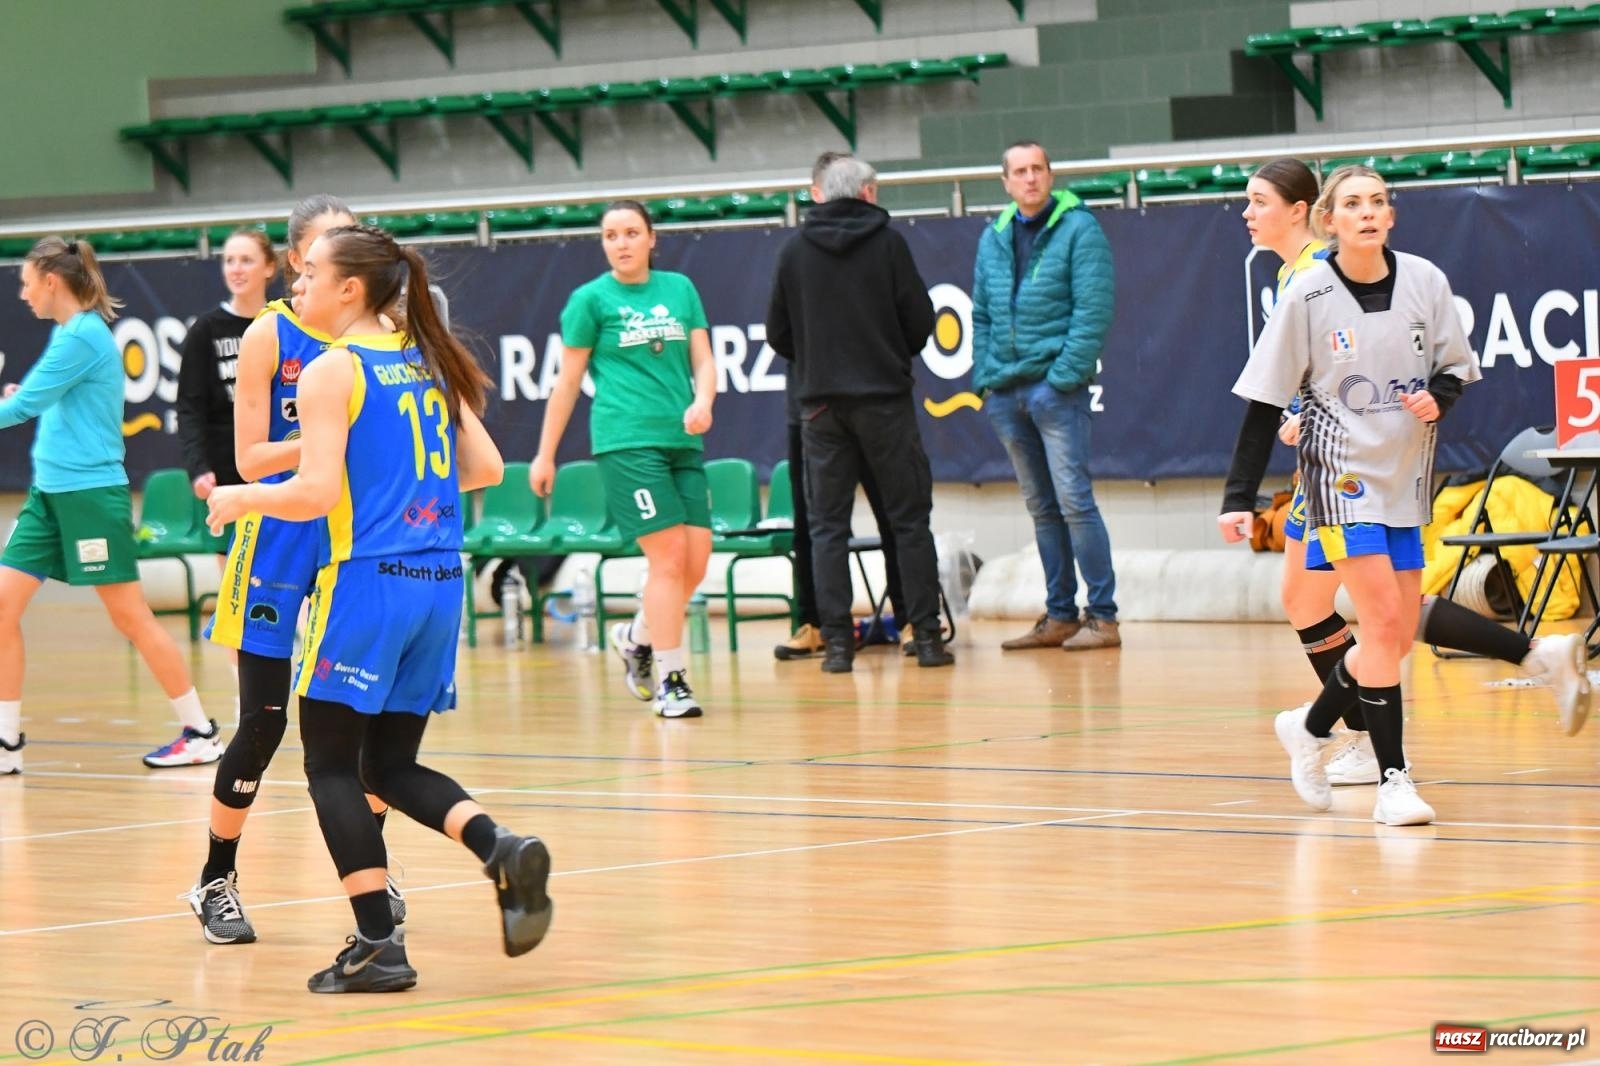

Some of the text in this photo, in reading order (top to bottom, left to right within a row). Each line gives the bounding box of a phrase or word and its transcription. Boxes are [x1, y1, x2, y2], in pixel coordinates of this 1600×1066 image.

[1567, 367, 1600, 428] 5
[397, 387, 451, 481] 13
[633, 488, 657, 520] 9
